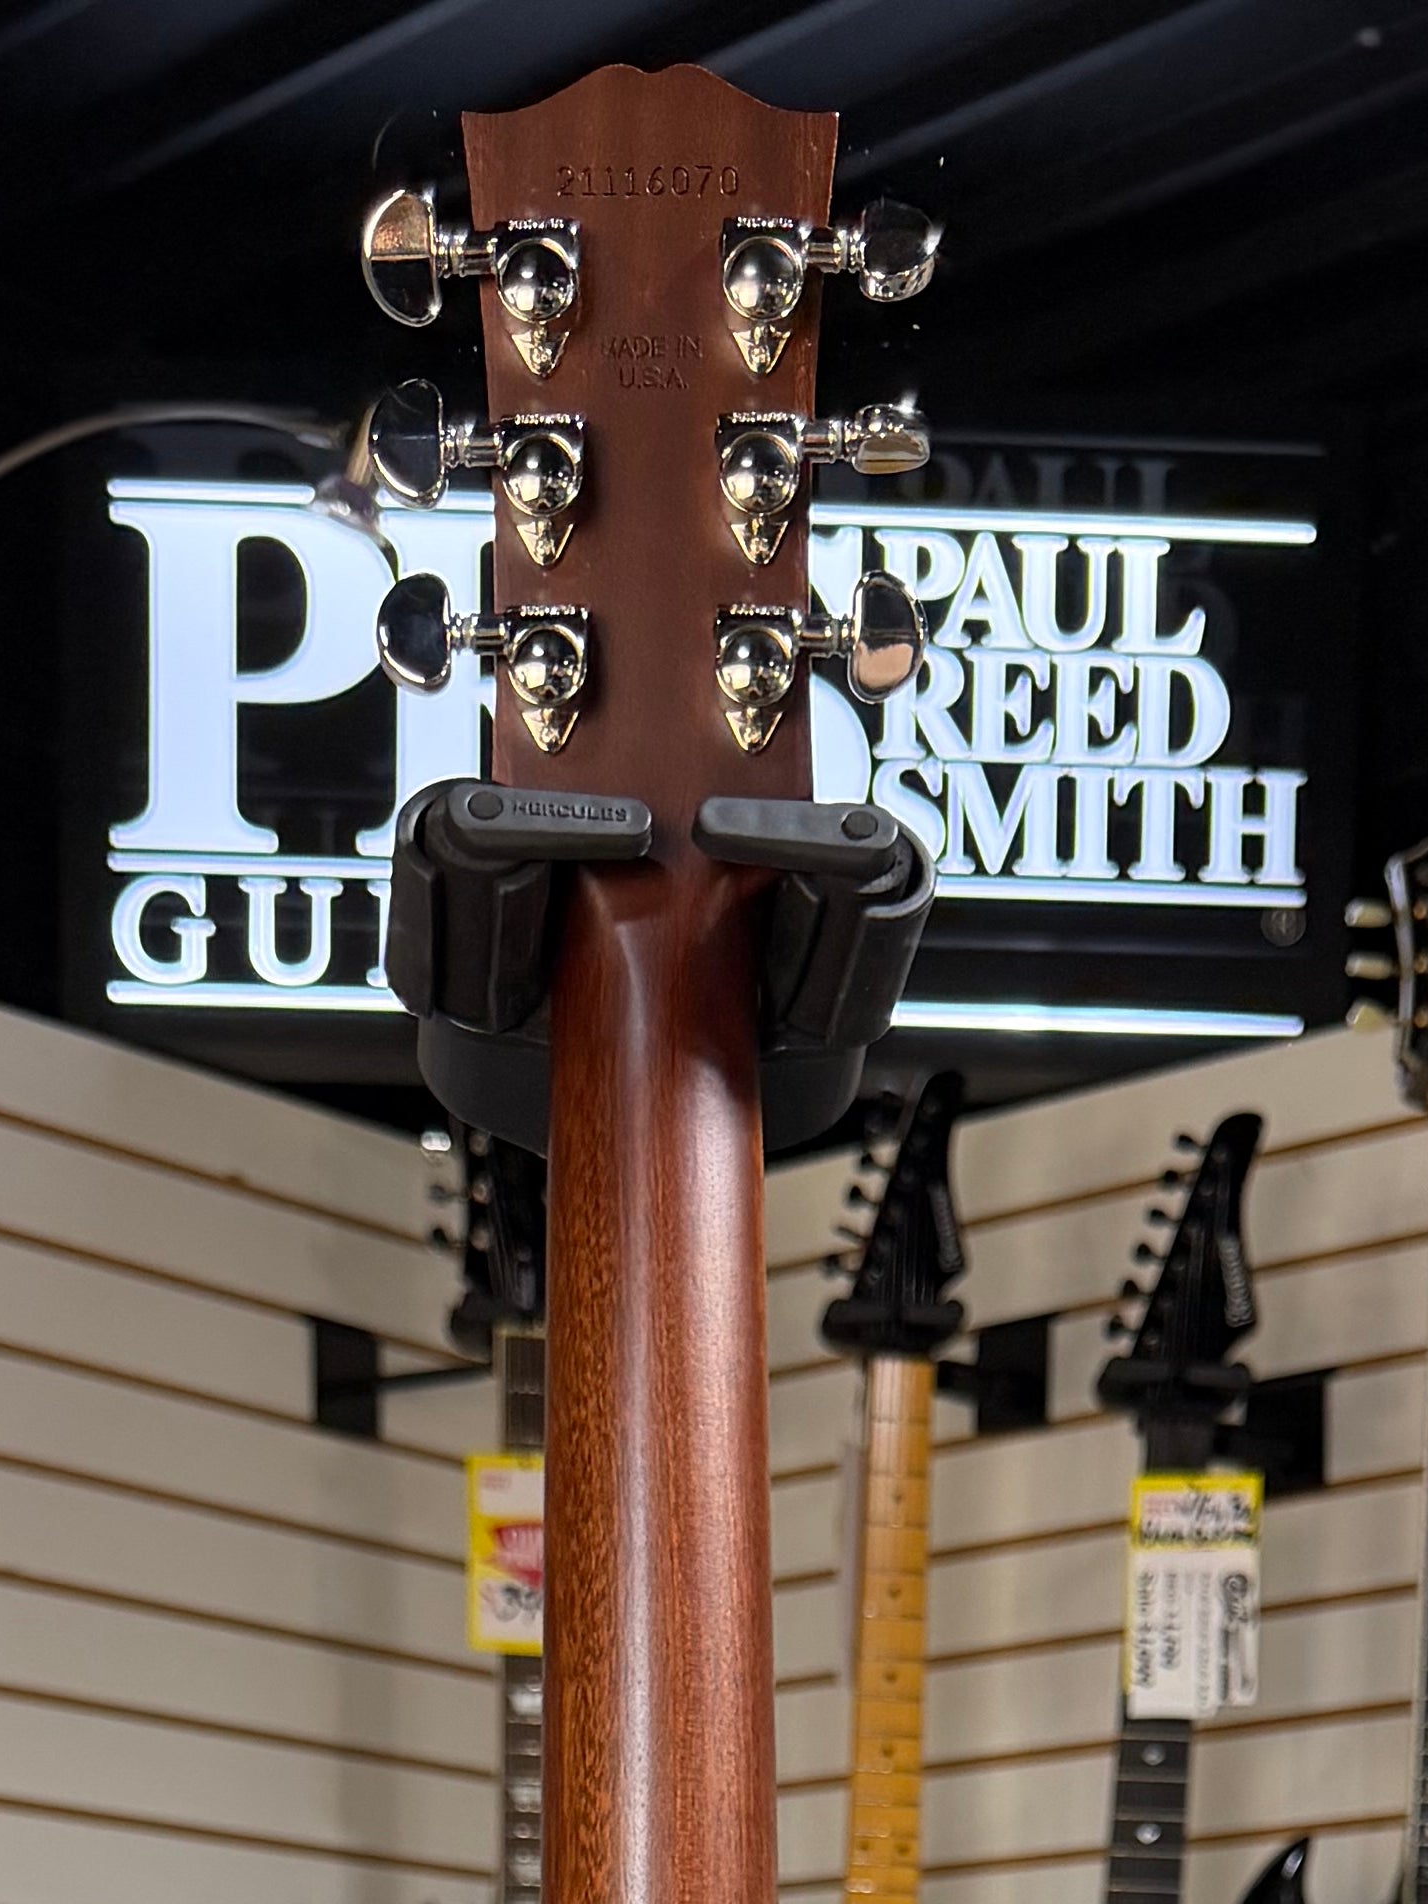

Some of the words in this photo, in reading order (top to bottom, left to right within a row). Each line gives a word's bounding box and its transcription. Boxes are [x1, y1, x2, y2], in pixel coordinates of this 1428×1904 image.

[600, 335, 666, 360] MADE
[677, 335, 704, 359] IN
[875, 528, 1207, 656] PAUL
[873, 645, 1232, 768] REED
[512, 801, 630, 823] HERCULES
[873, 757, 1308, 885] SMITH
